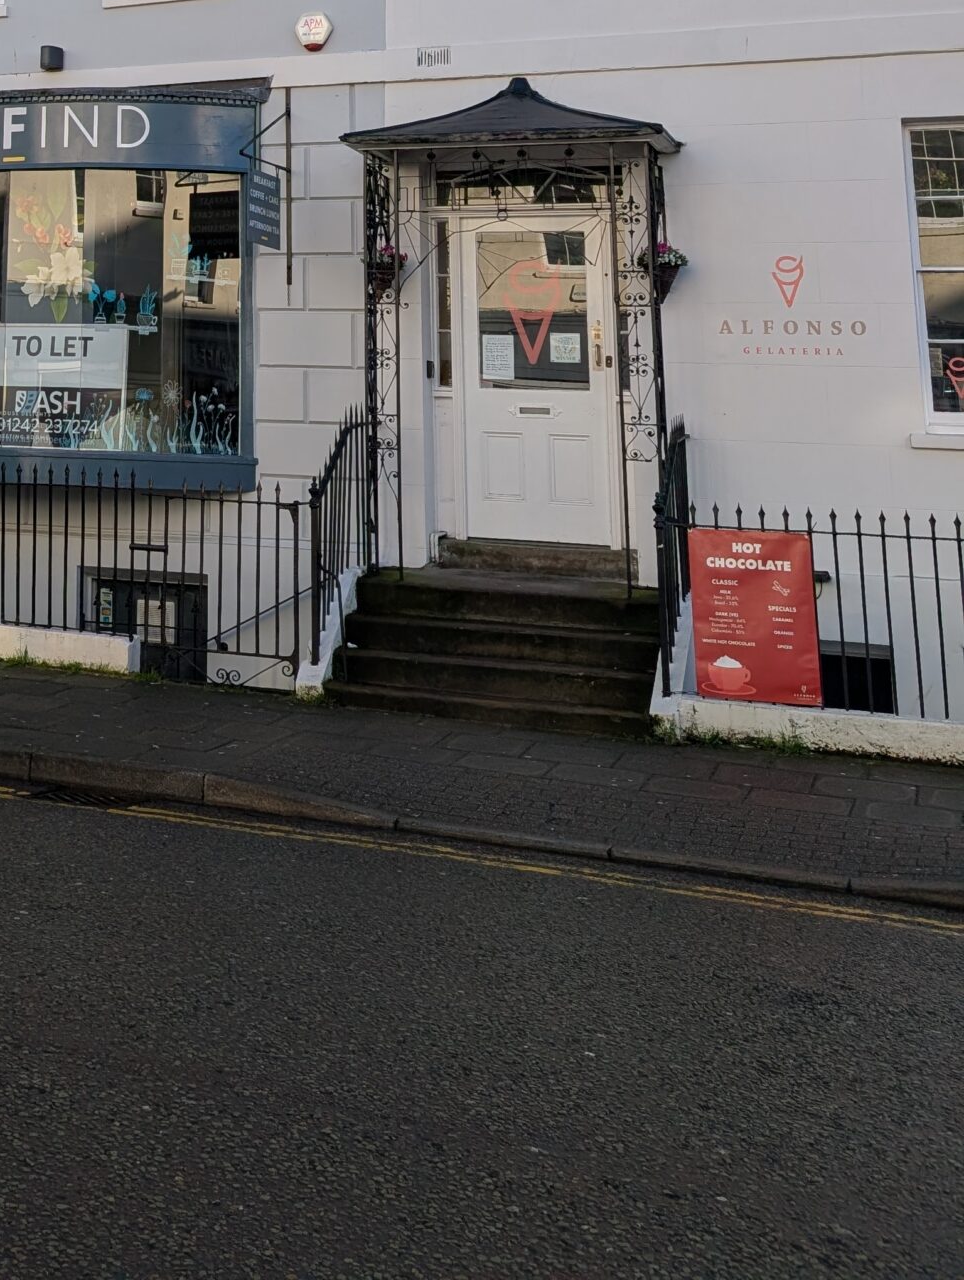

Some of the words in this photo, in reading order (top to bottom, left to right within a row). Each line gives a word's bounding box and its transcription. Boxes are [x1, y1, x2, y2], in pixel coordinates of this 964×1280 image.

[253, 175, 276, 190] BREAKFAST
[249, 188, 265, 201] COFFEE
[249, 203, 266, 216] BRUNCH
[249, 220, 272, 233] AFTERNOON
[718, 319, 867, 336] ALFONSO
[11, 335, 43, 357] TO
[49, 335, 94, 358] LET
[743, 346, 844, 357] GELATERIA
[31, 390, 81, 415] ASH
[44, 419, 99, 435] 237274
[731, 542, 762, 554] HOT
[706, 556, 792, 572] CHOCOLATE
[711, 578, 739, 586] CLASSIC
[767, 605, 797, 613] SPECIALS
